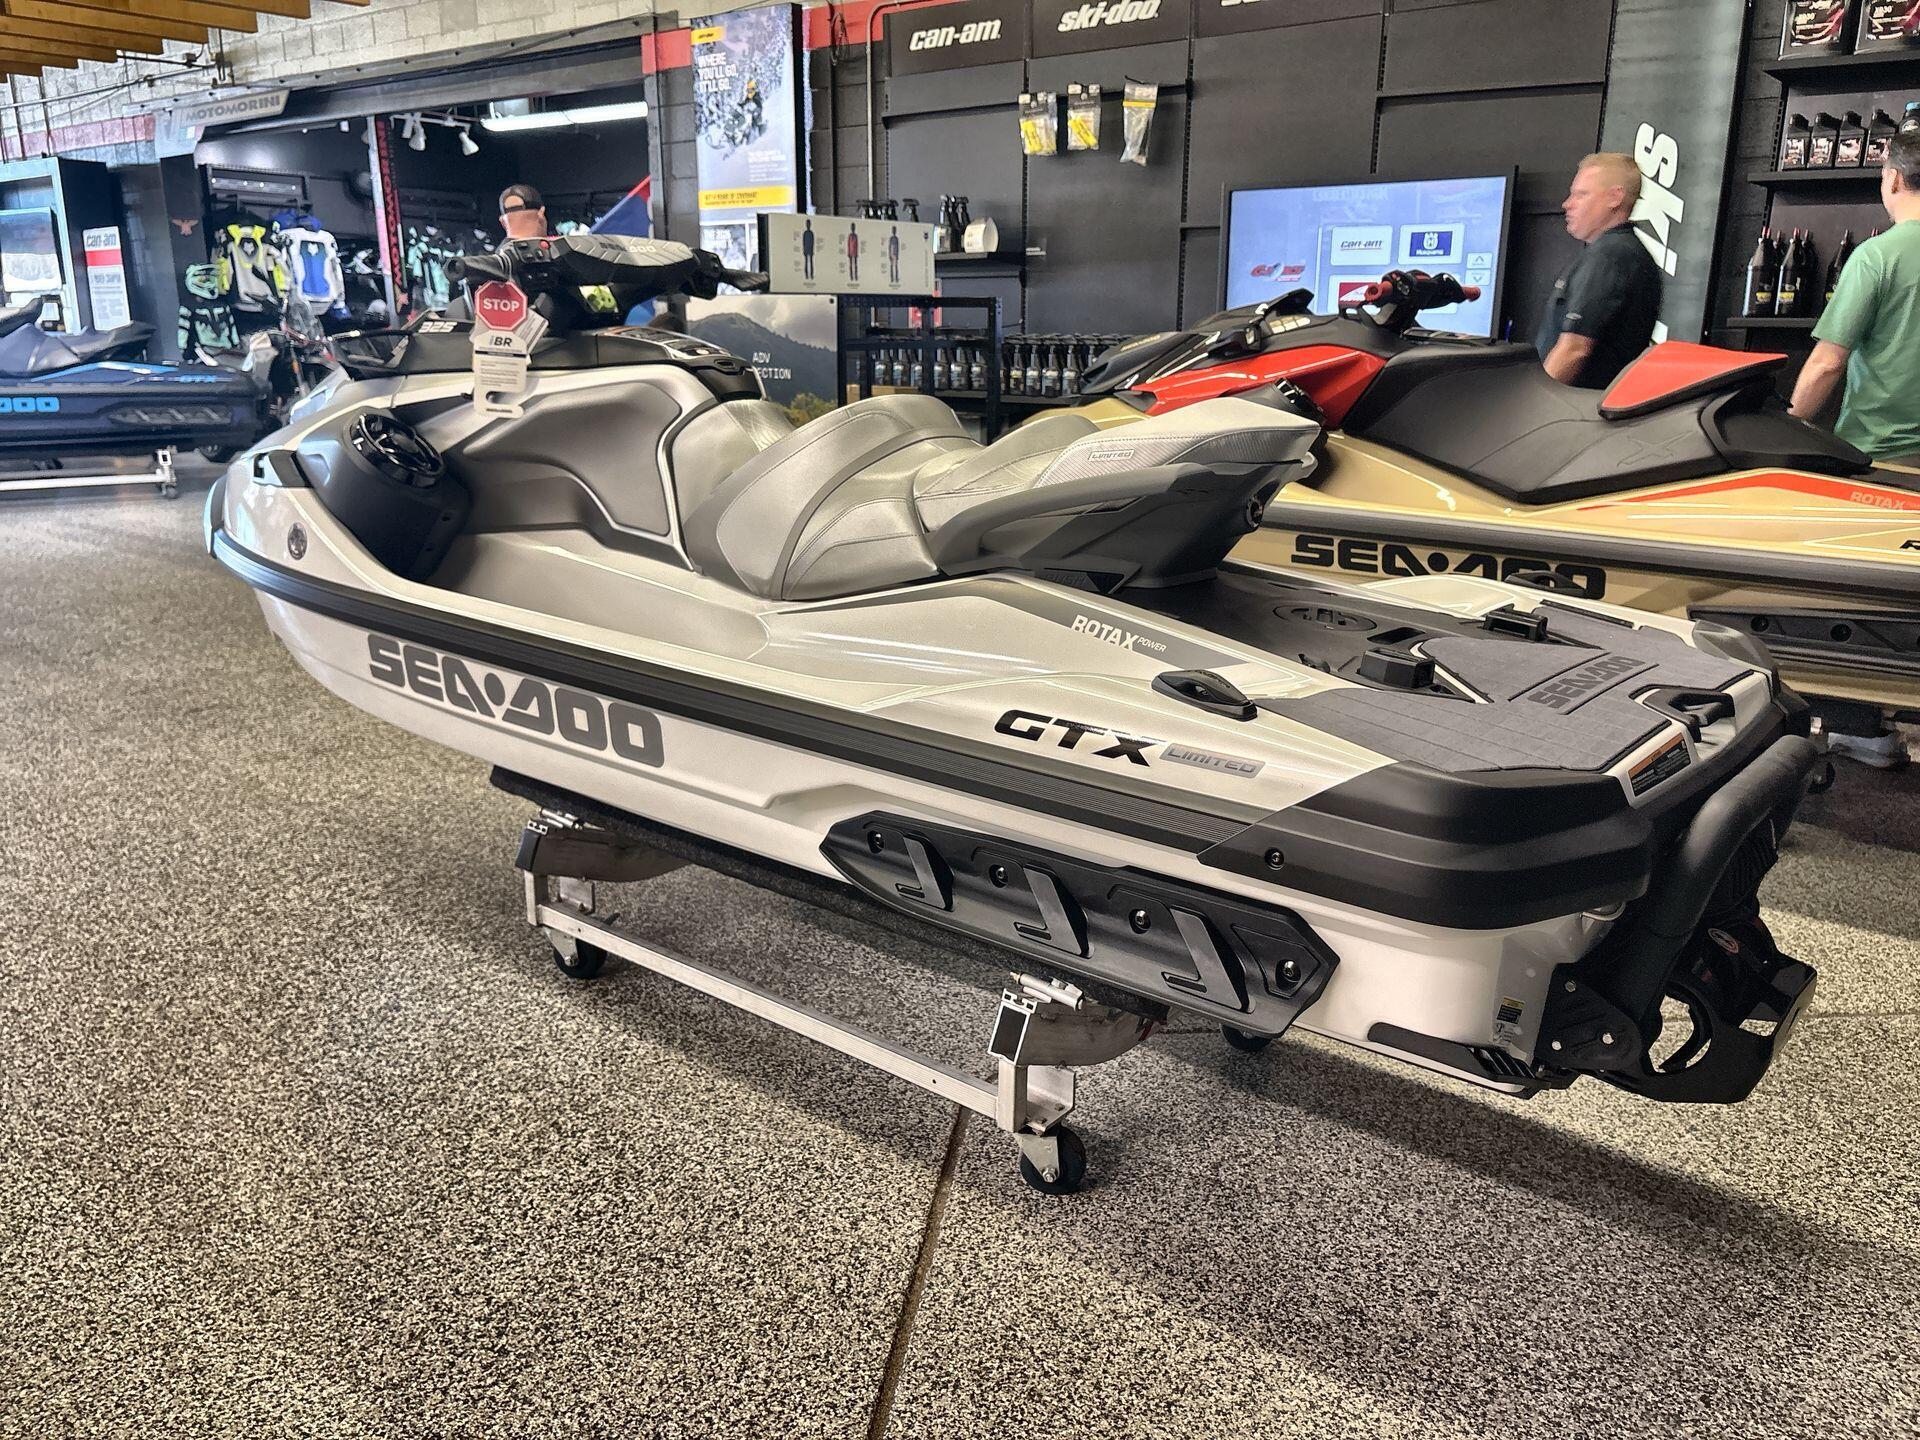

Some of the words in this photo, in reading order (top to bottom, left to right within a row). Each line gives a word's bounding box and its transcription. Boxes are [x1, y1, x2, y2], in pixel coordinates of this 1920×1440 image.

[1057, 0, 1160, 32] ski-doo
[909, 19, 1001, 51] can-am
[698, 52, 726, 66] WHERE
[483, 298, 520, 312] STOP
[752, 351, 771, 363] ADV
[1850, 491, 1906, 510] ROTAX
[1070, 614, 1139, 652] ROTAX
[1137, 636, 1167, 653] POWER
[994, 709, 1165, 767] GTX
[1165, 746, 1258, 775] LIMITED
